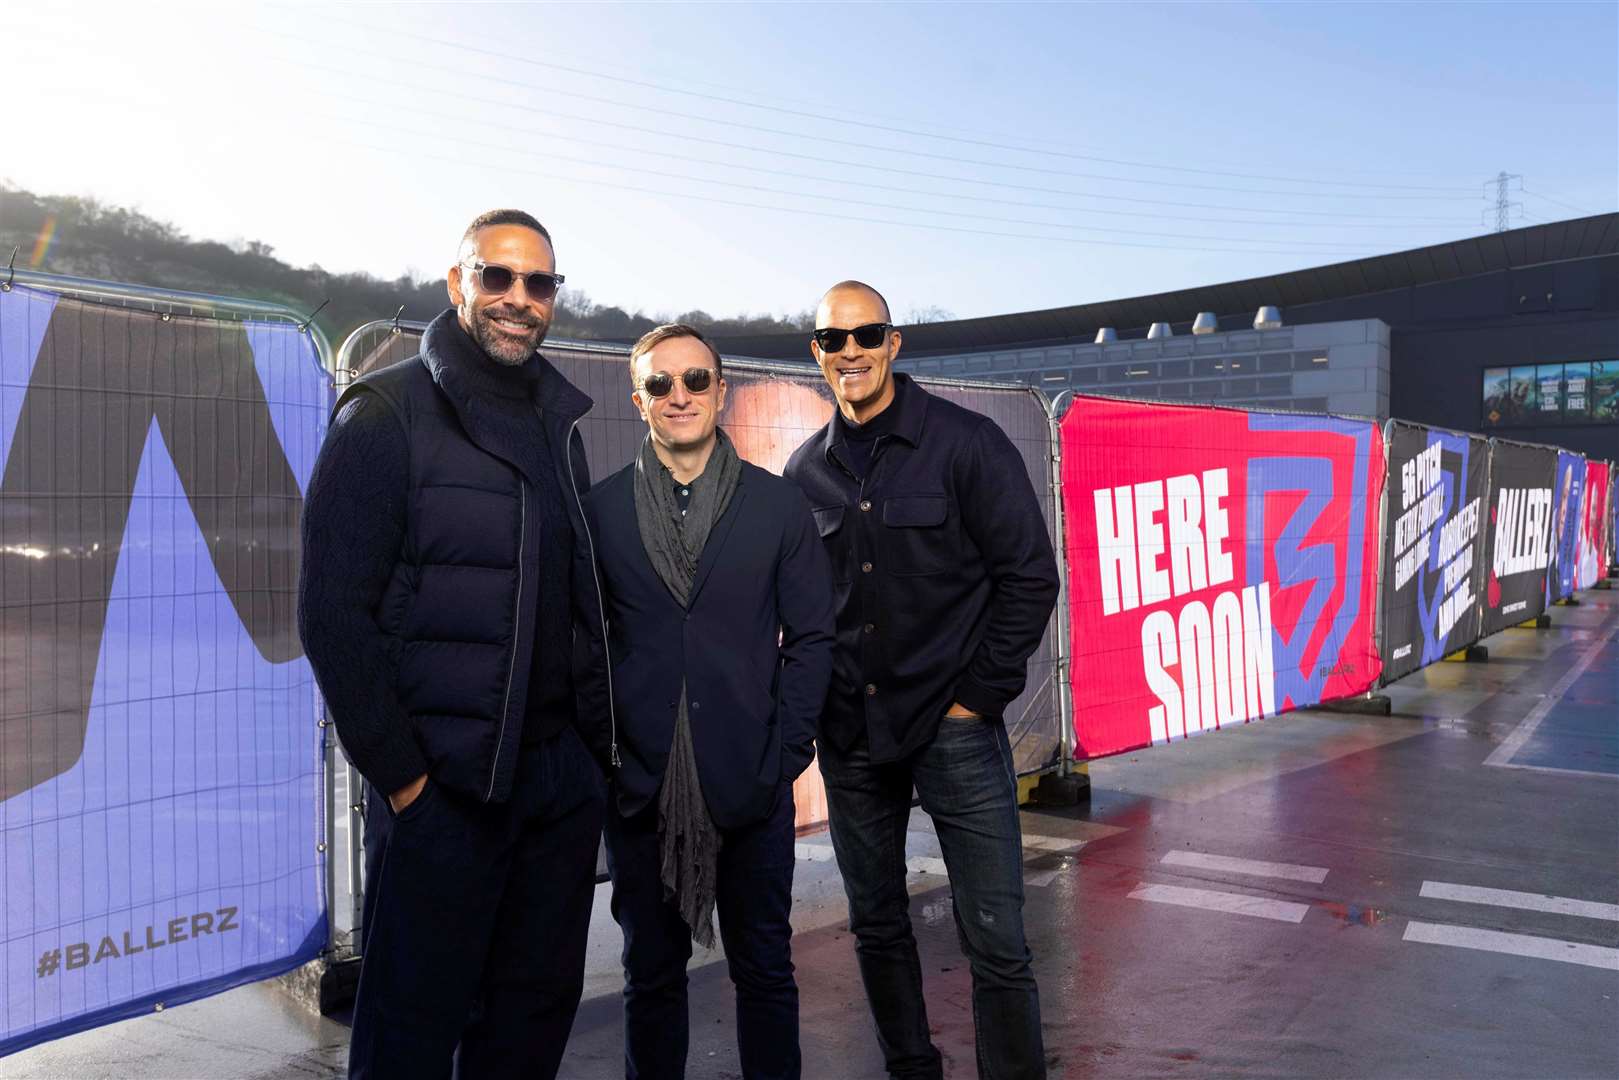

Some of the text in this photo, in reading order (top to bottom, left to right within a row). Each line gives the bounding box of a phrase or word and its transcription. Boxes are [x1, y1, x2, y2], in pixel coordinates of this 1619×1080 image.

[1402, 440, 1441, 510] 5G PITCH
[1093, 467, 1233, 616] HERE
[1493, 487, 1552, 578] BALLERZ
[1141, 581, 1276, 744] SOON
[36, 906, 239, 978] #BALLERZ
